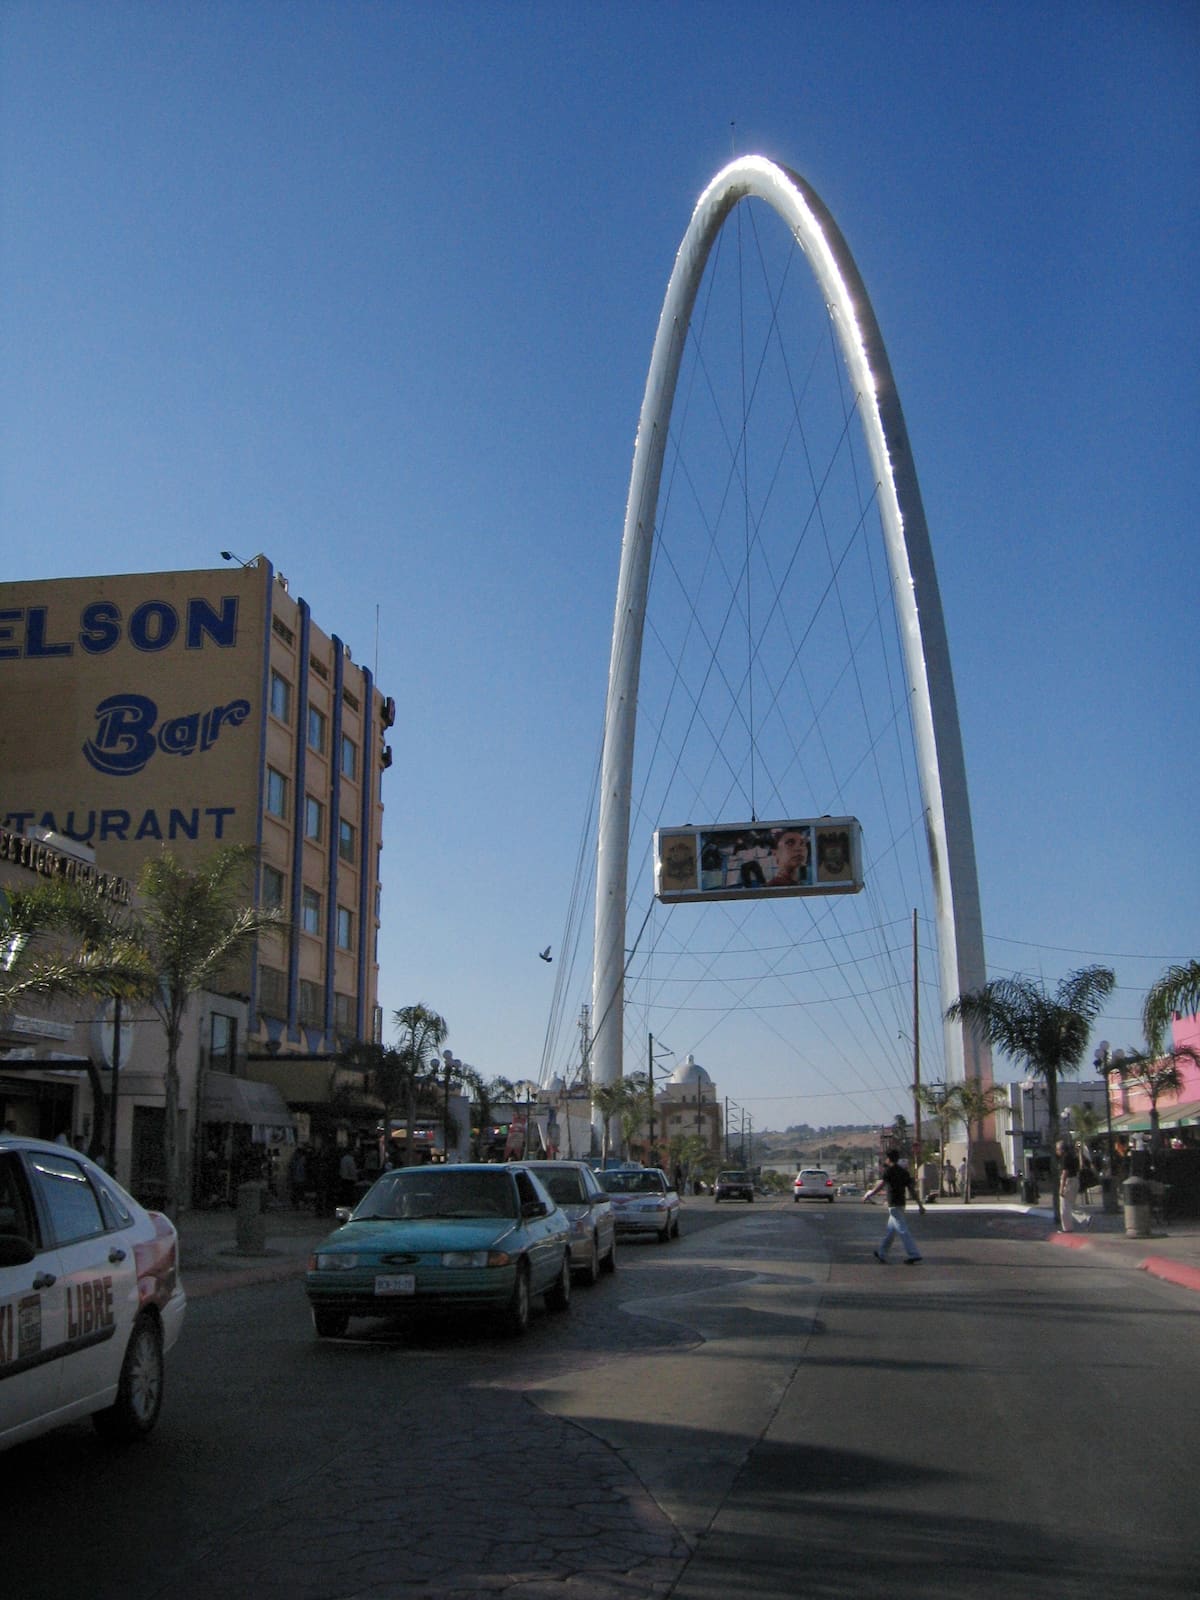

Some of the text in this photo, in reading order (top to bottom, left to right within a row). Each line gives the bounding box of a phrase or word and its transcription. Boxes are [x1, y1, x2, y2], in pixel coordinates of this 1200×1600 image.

[0, 596, 238, 660] ELSON
[82, 693, 250, 776] Bar
[67, 1276, 114, 1338] LIBRE
